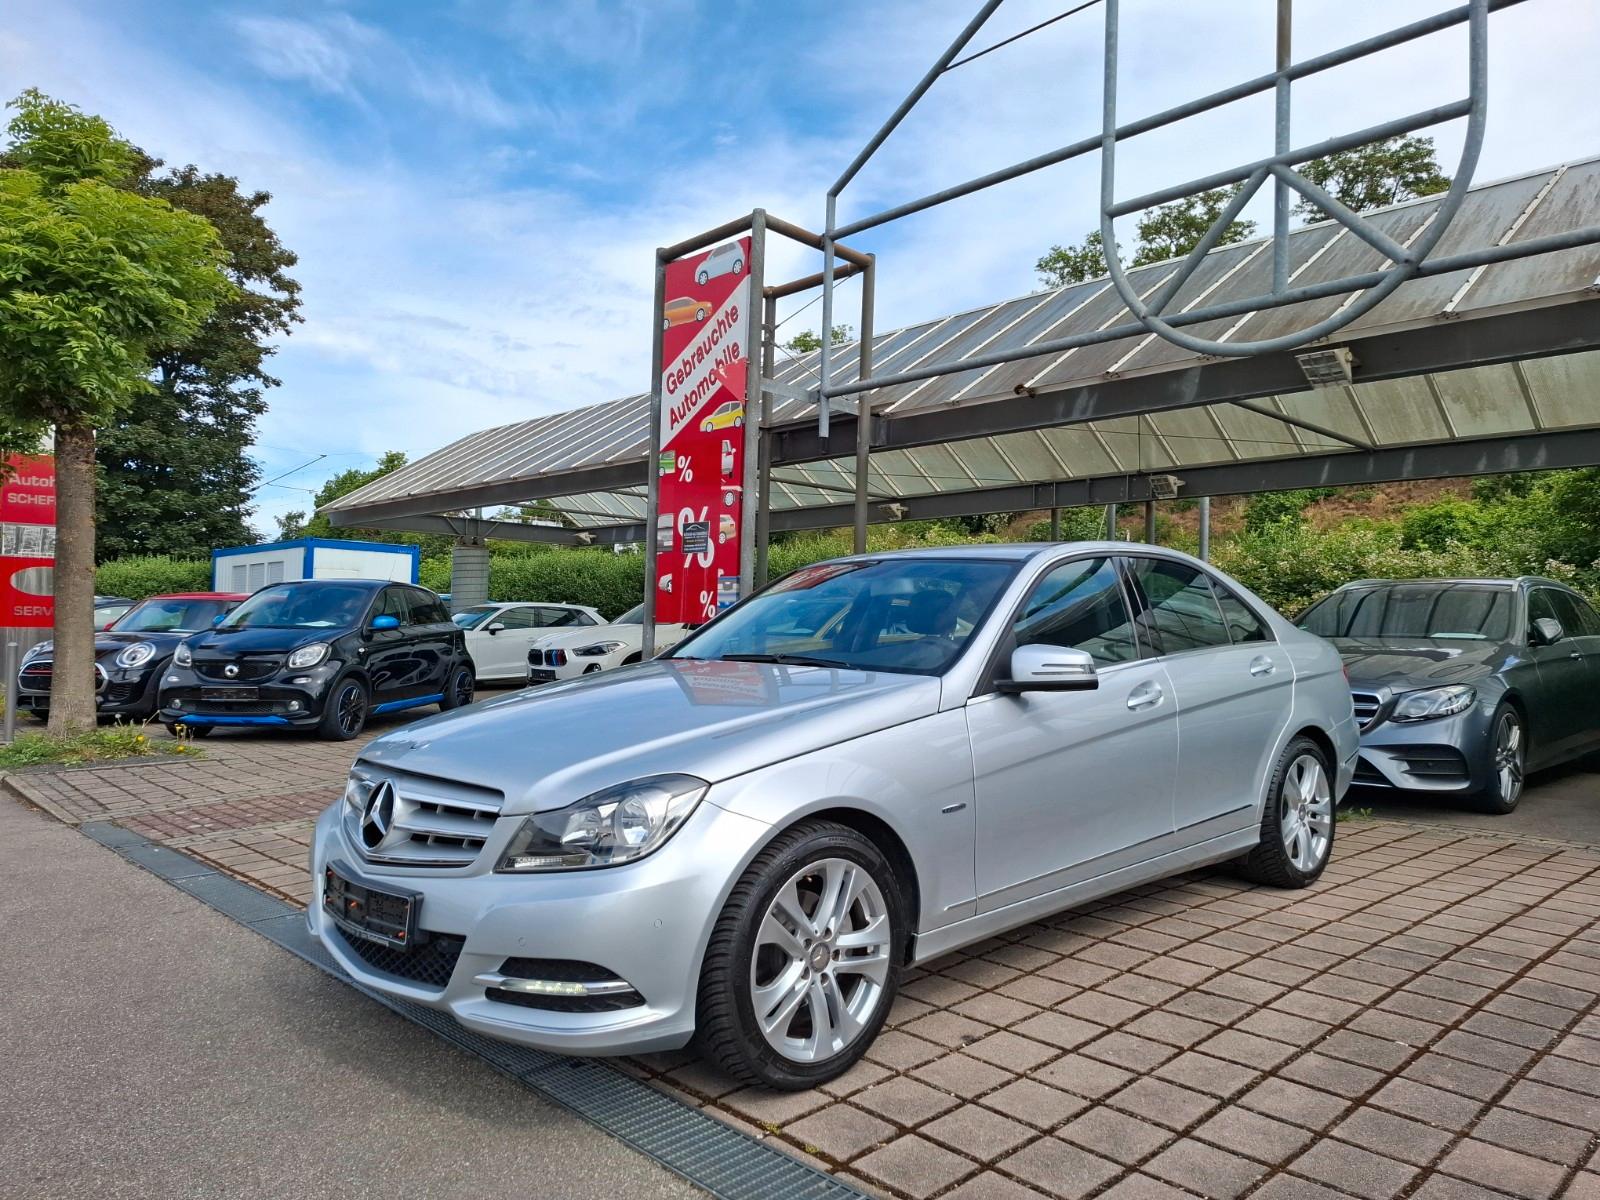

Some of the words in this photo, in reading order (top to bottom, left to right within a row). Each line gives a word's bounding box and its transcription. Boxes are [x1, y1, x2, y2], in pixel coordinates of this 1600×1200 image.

[666, 305, 739, 395] Gebrauchte
[677, 455, 693, 482] %
[7, 492, 56, 505] SCHEF
[700, 590, 716, 618] %
